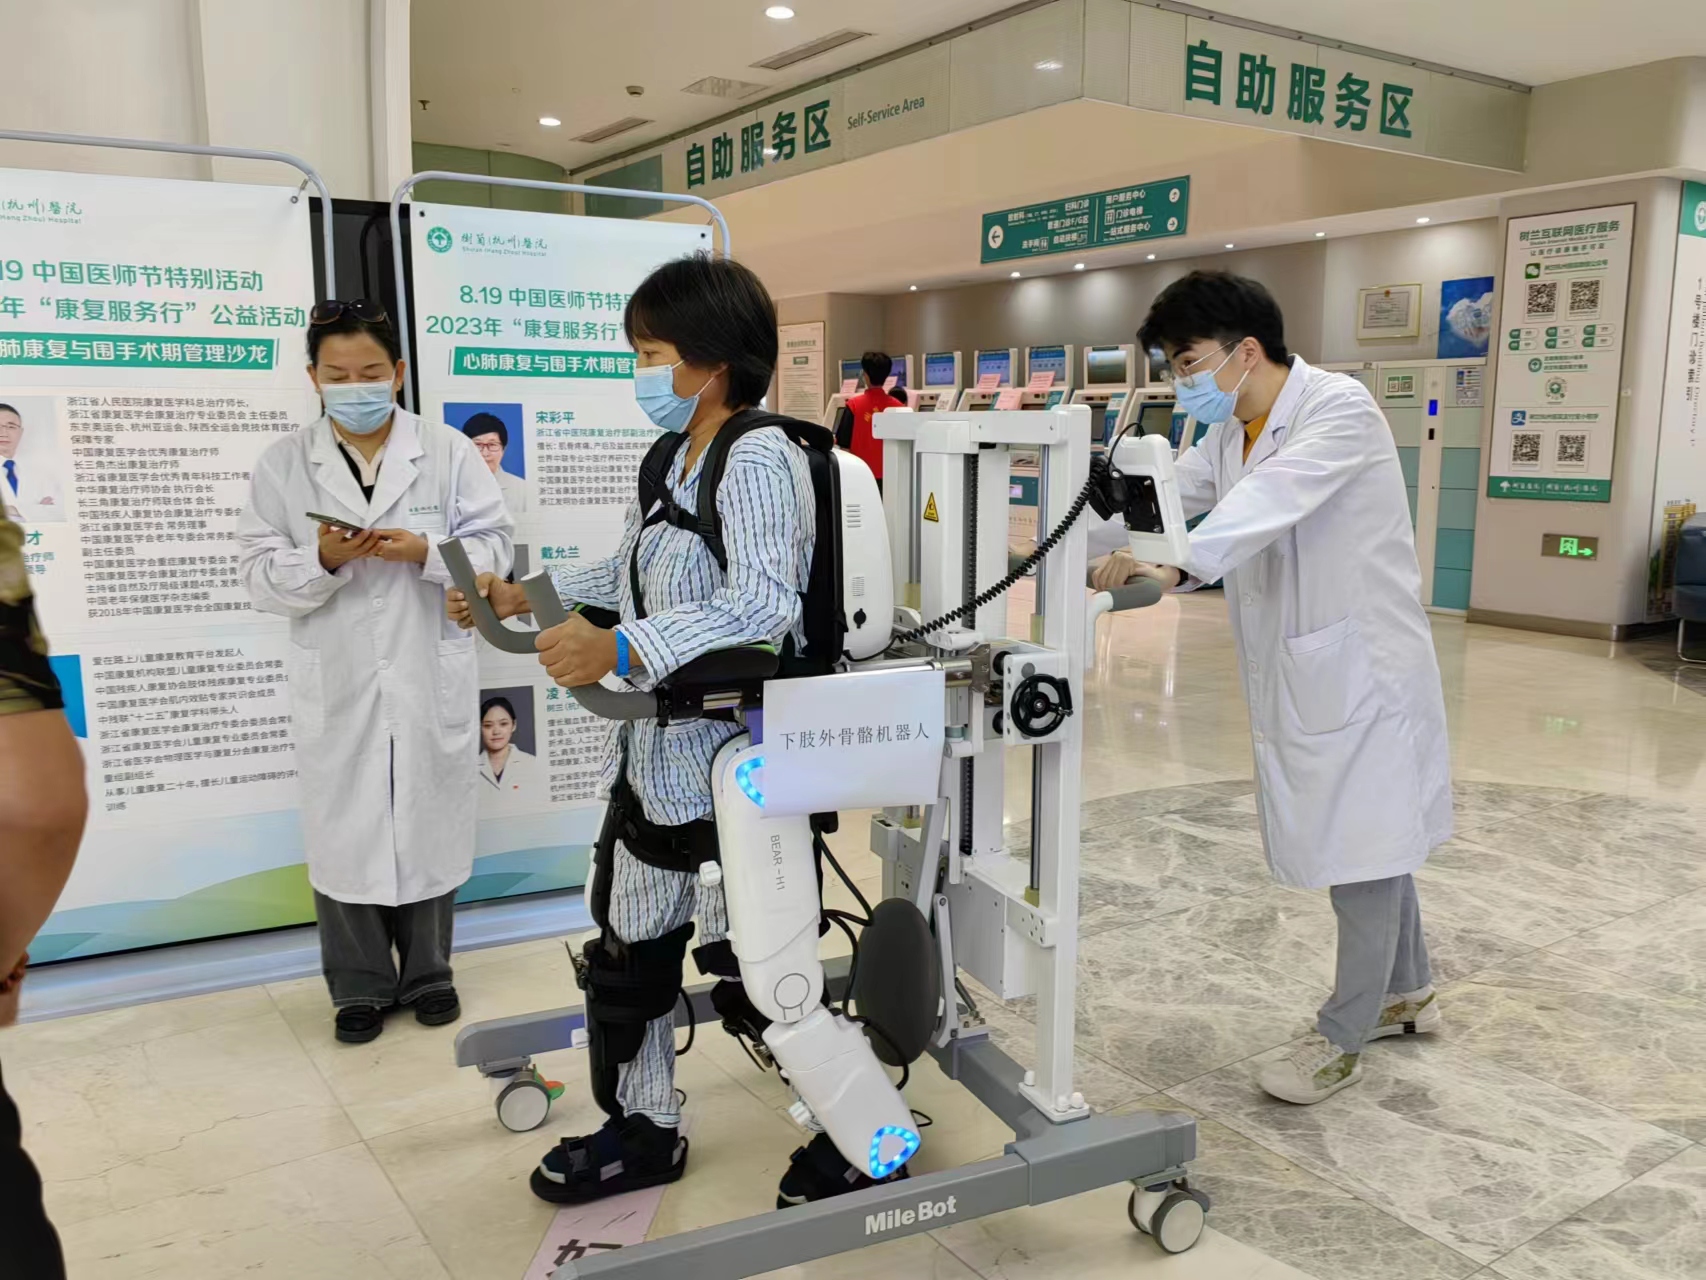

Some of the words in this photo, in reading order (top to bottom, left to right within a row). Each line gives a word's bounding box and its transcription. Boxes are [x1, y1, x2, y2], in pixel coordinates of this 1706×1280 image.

[1186, 40, 1413, 138] 自助服务区
[686, 99, 831, 190] 自助服务区
[847, 102, 900, 131] Self-Service
[901, 97, 925, 114] Area
[1105, 189, 1146, 205] 用户服务中心
[1103, 221, 1152, 237] 一站式服务中心
[1519, 220, 1620, 242] 树兰互联网医疗服务
[32, 260, 264, 292] 中国医师节特别活动
[459, 284, 502, 305] 8.19
[535, 410, 576, 425] 宋彩平
[70, 435, 115, 445] 保障专家
[779, 722, 930, 750] 下肢外骨骼机器人
